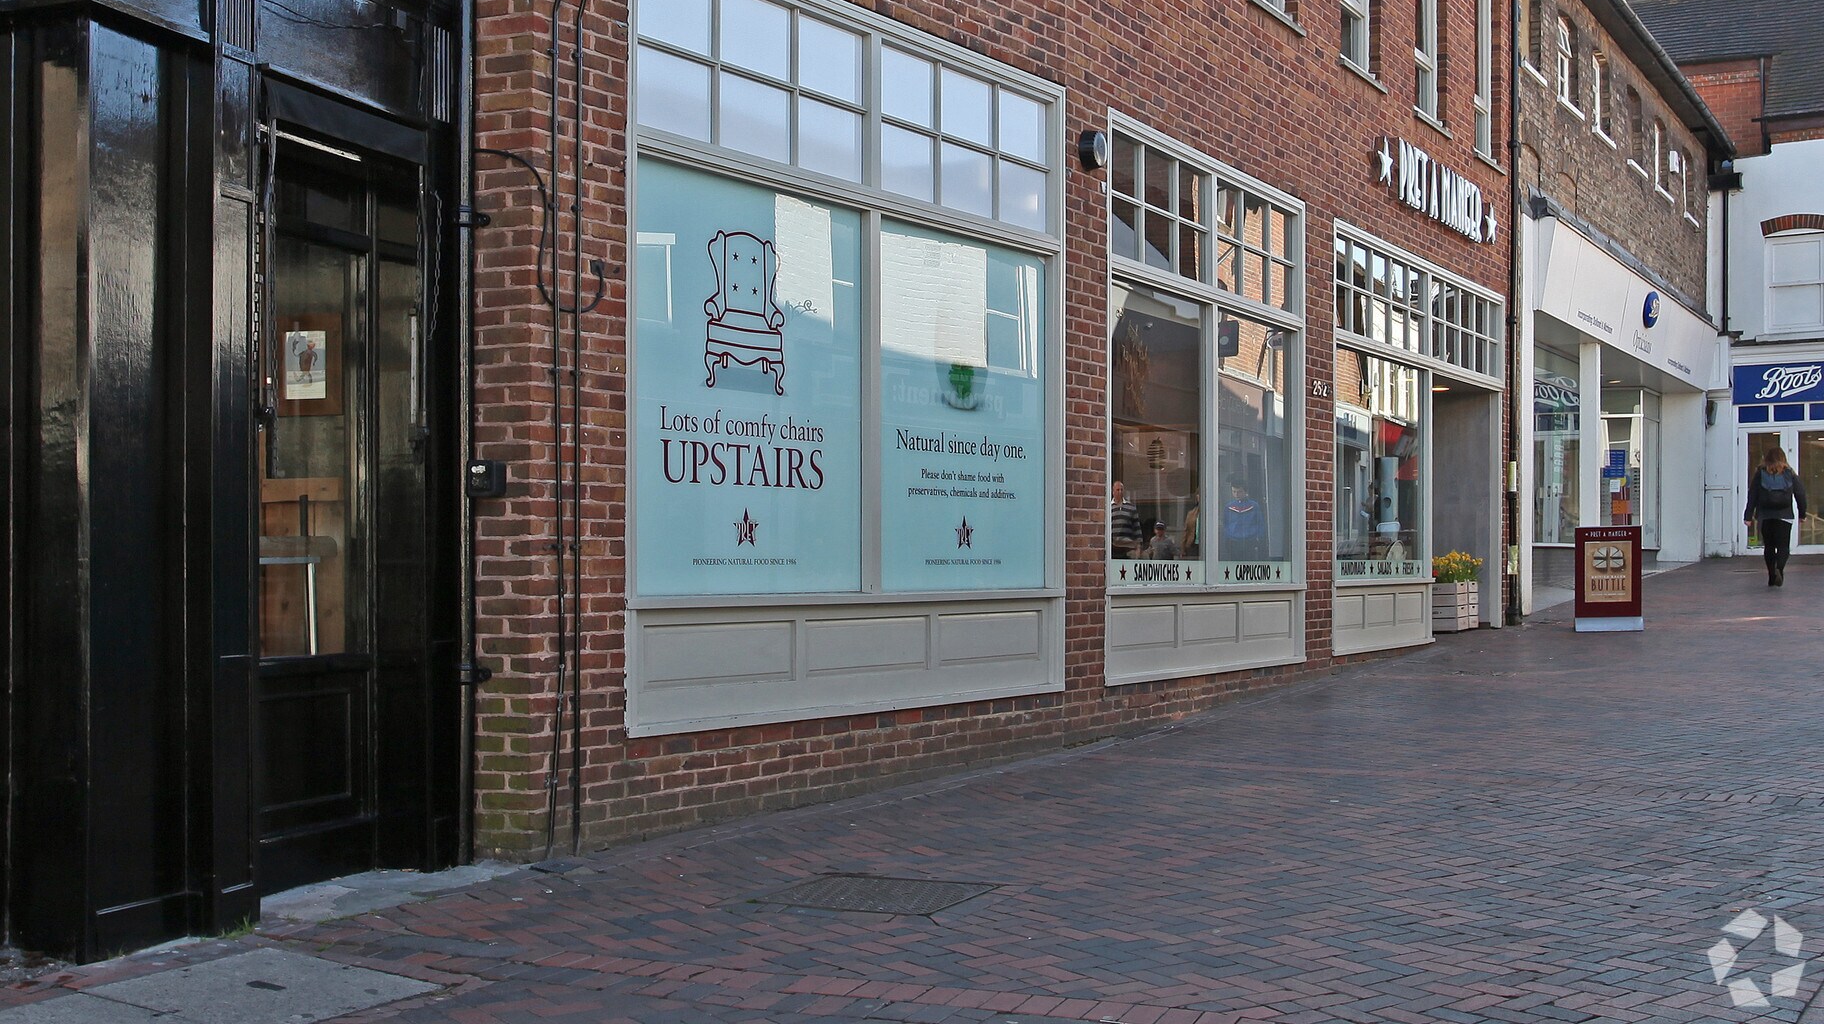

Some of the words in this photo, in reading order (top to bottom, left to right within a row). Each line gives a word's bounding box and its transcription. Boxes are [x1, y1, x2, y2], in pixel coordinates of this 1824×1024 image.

[1398, 136, 1429, 213] PRET
[1429, 158, 1440, 220] A
[1440, 163, 1483, 244] MANGER
[1754, 364, 1823, 399] Boots
[660, 405, 699, 432] Lots
[703, 409, 722, 434] of
[725, 413, 777, 445] comfy
[780, 416, 825, 443] chairs
[896, 428, 946, 453] Natural
[948, 434, 977, 456] since
[980, 436, 1001, 463] day
[1003, 444, 1027, 460] one.
[660, 438, 825, 491] UPSTAIRS
[921, 468, 940, 479] Please
[941, 469, 957, 481] don't
[958, 470, 976, 482] shame
[977, 471, 991, 483] food
[992, 472, 1005, 484] with
[908, 486, 949, 498] preservatives,
[949, 486, 978, 498] chemicals
[979, 487, 990, 498] and
[990, 487, 1017, 500] additives.
[692, 558, 727, 566] PIONEERING
[727, 558, 754, 566] NATURAL
[754, 558, 770, 566] FOOD
[770, 558, 785, 566] SINCE
[1133, 563, 1179, 582] SANDWICHES
[1235, 564, 1271, 581] CAPPUCCINO
[1591, 578, 1626, 592] BUTTIE
